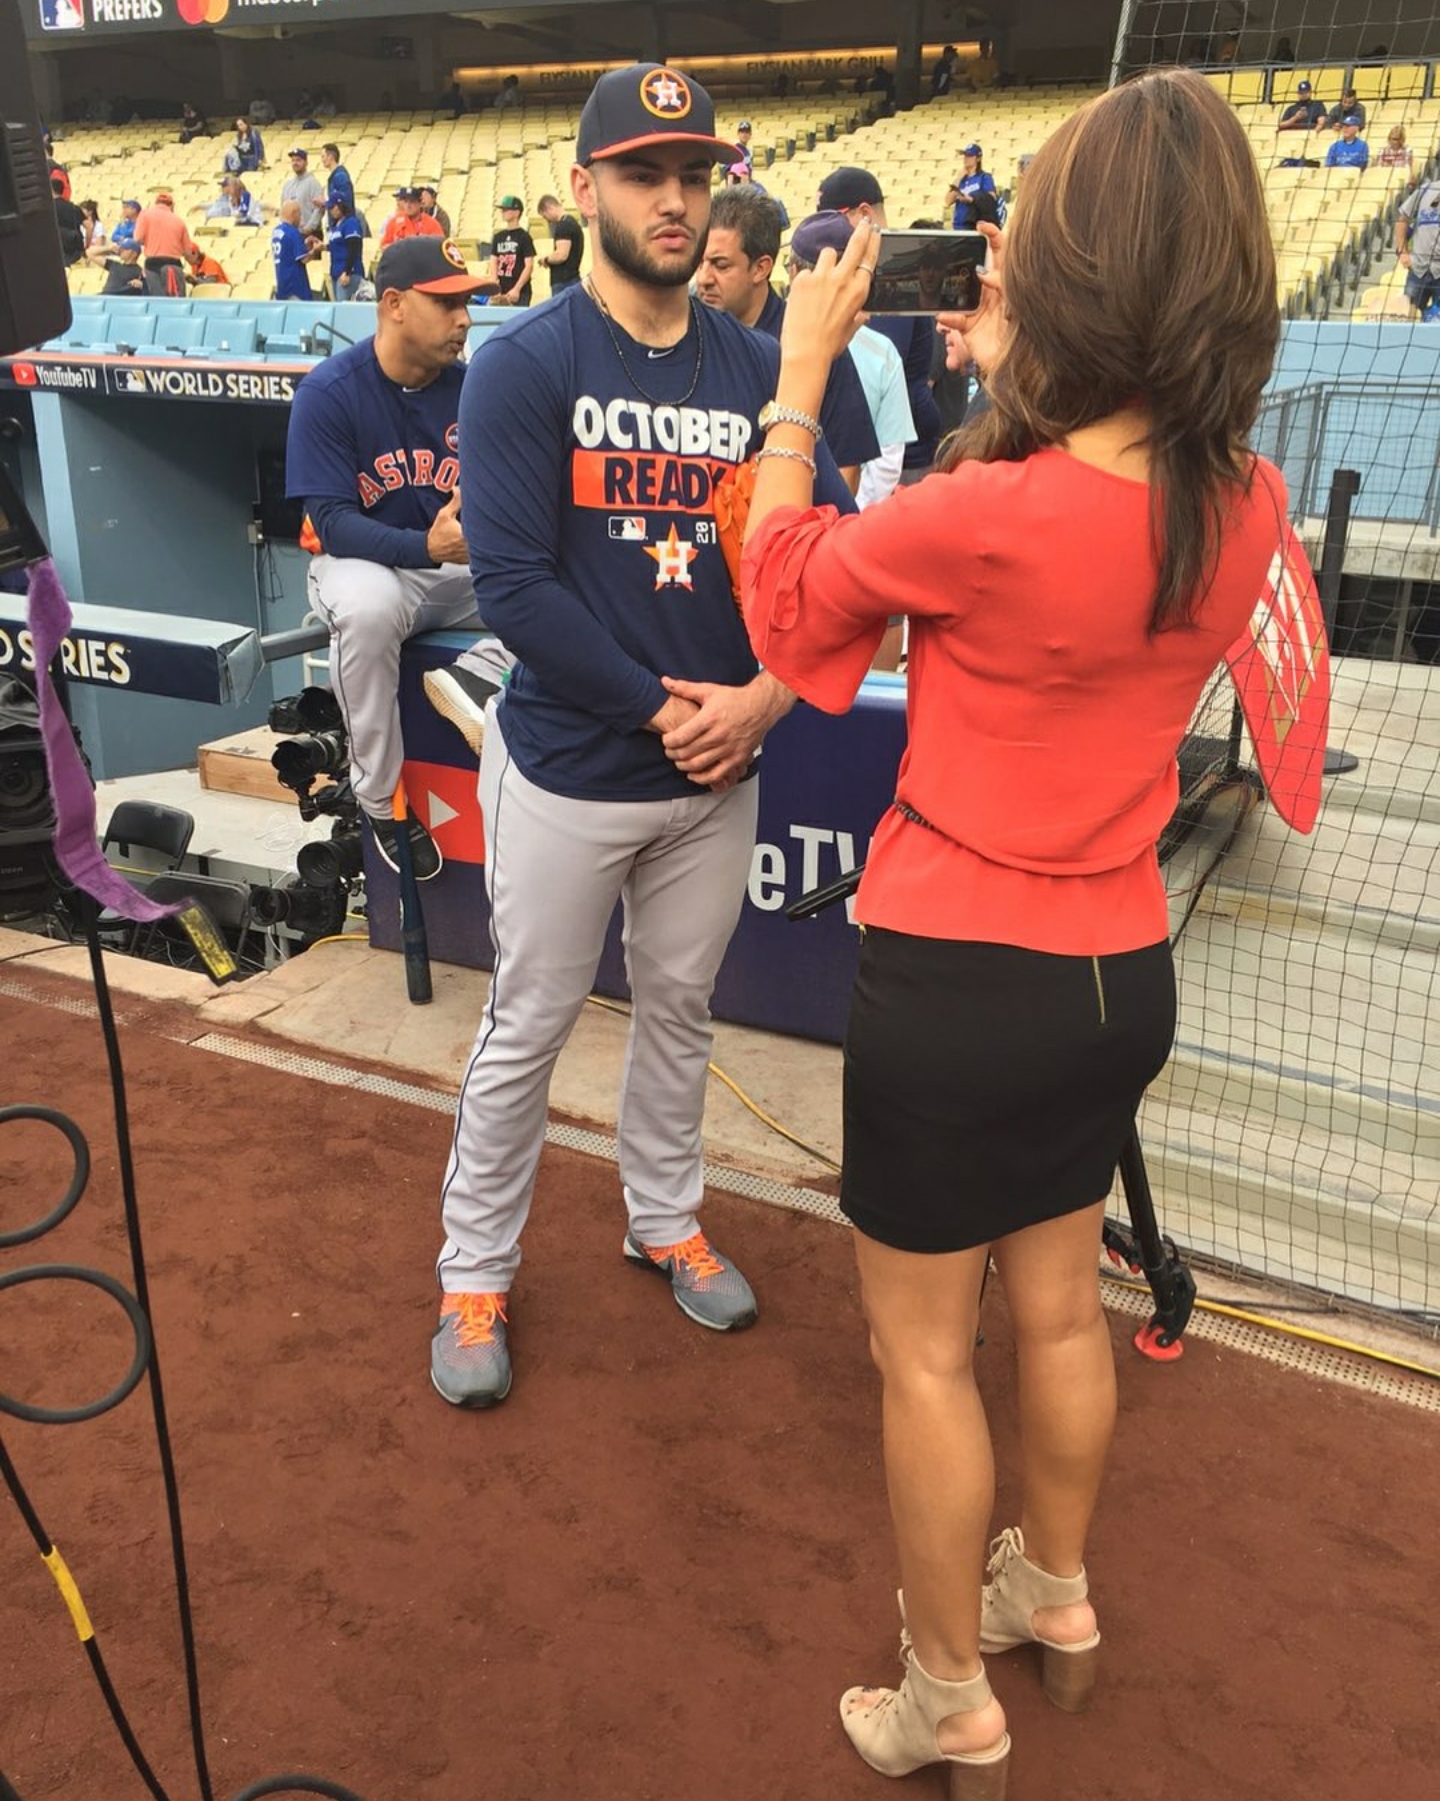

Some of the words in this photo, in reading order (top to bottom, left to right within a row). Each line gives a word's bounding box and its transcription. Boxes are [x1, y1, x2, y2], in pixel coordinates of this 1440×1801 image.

[92, 0, 163, 22] PREFERS
[807, 57, 843, 72] PARK
[145, 370, 224, 397] WORLD
[226, 373, 295, 402] SERIES
[573, 395, 752, 463] OCTOBER
[358, 449, 460, 508] ASTRO
[604, 457, 727, 509] READY
[18, 630, 131, 684] SRIES
